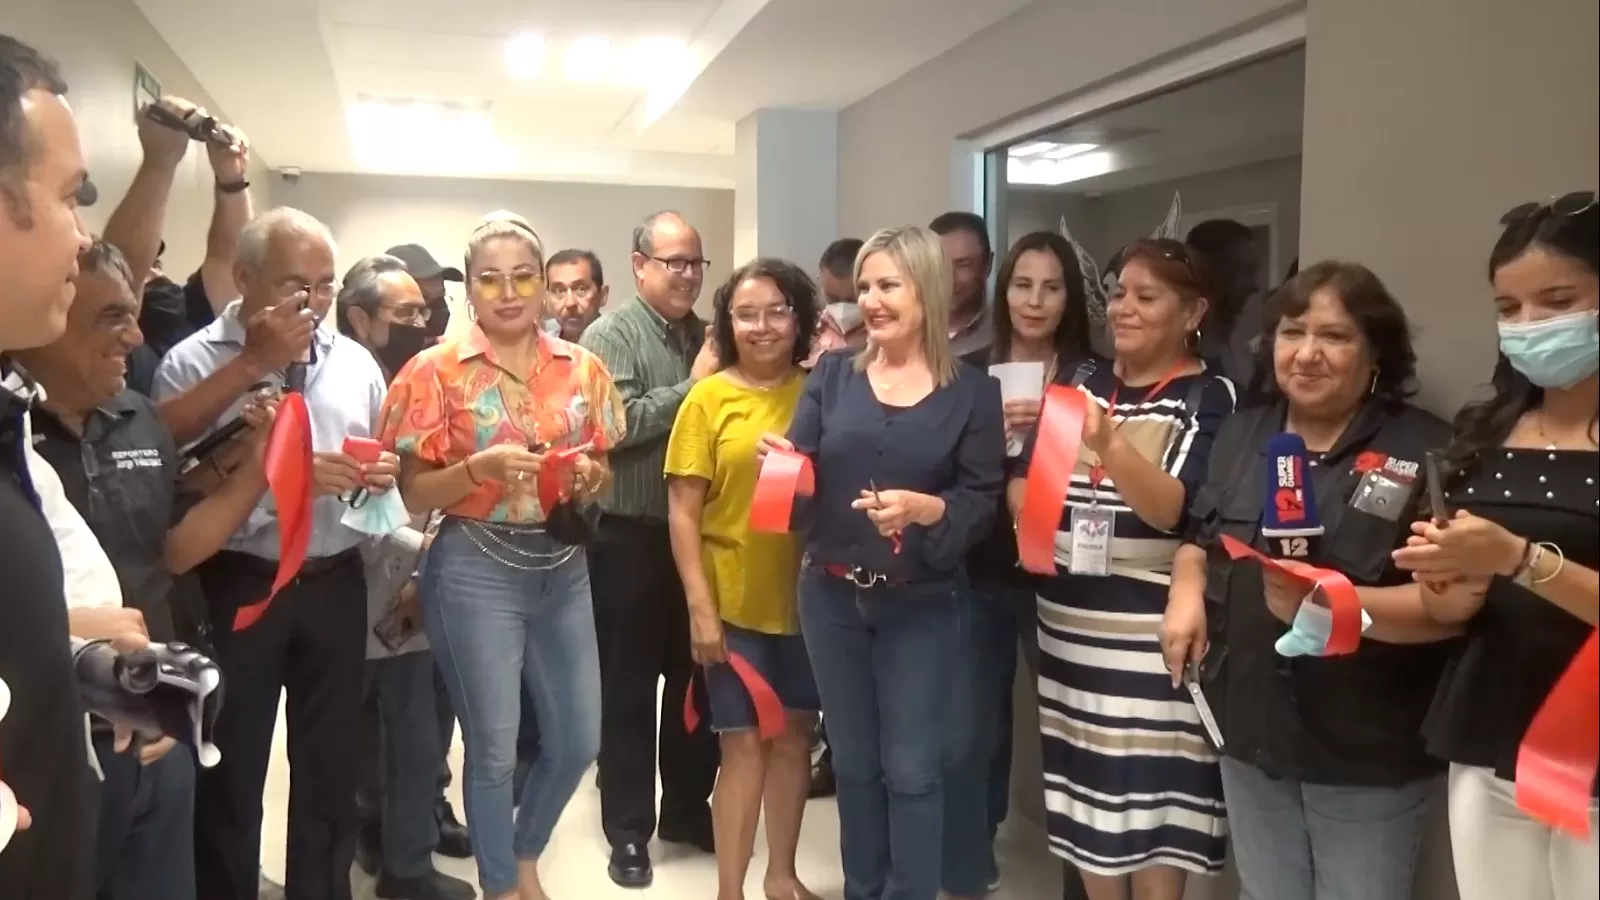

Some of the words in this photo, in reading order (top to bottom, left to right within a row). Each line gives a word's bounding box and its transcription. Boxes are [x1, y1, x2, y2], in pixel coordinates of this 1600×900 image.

[111, 449, 159, 459] REPORTERO
[1277, 456, 1287, 487] SUPER
[1280, 537, 1308, 556] 12
